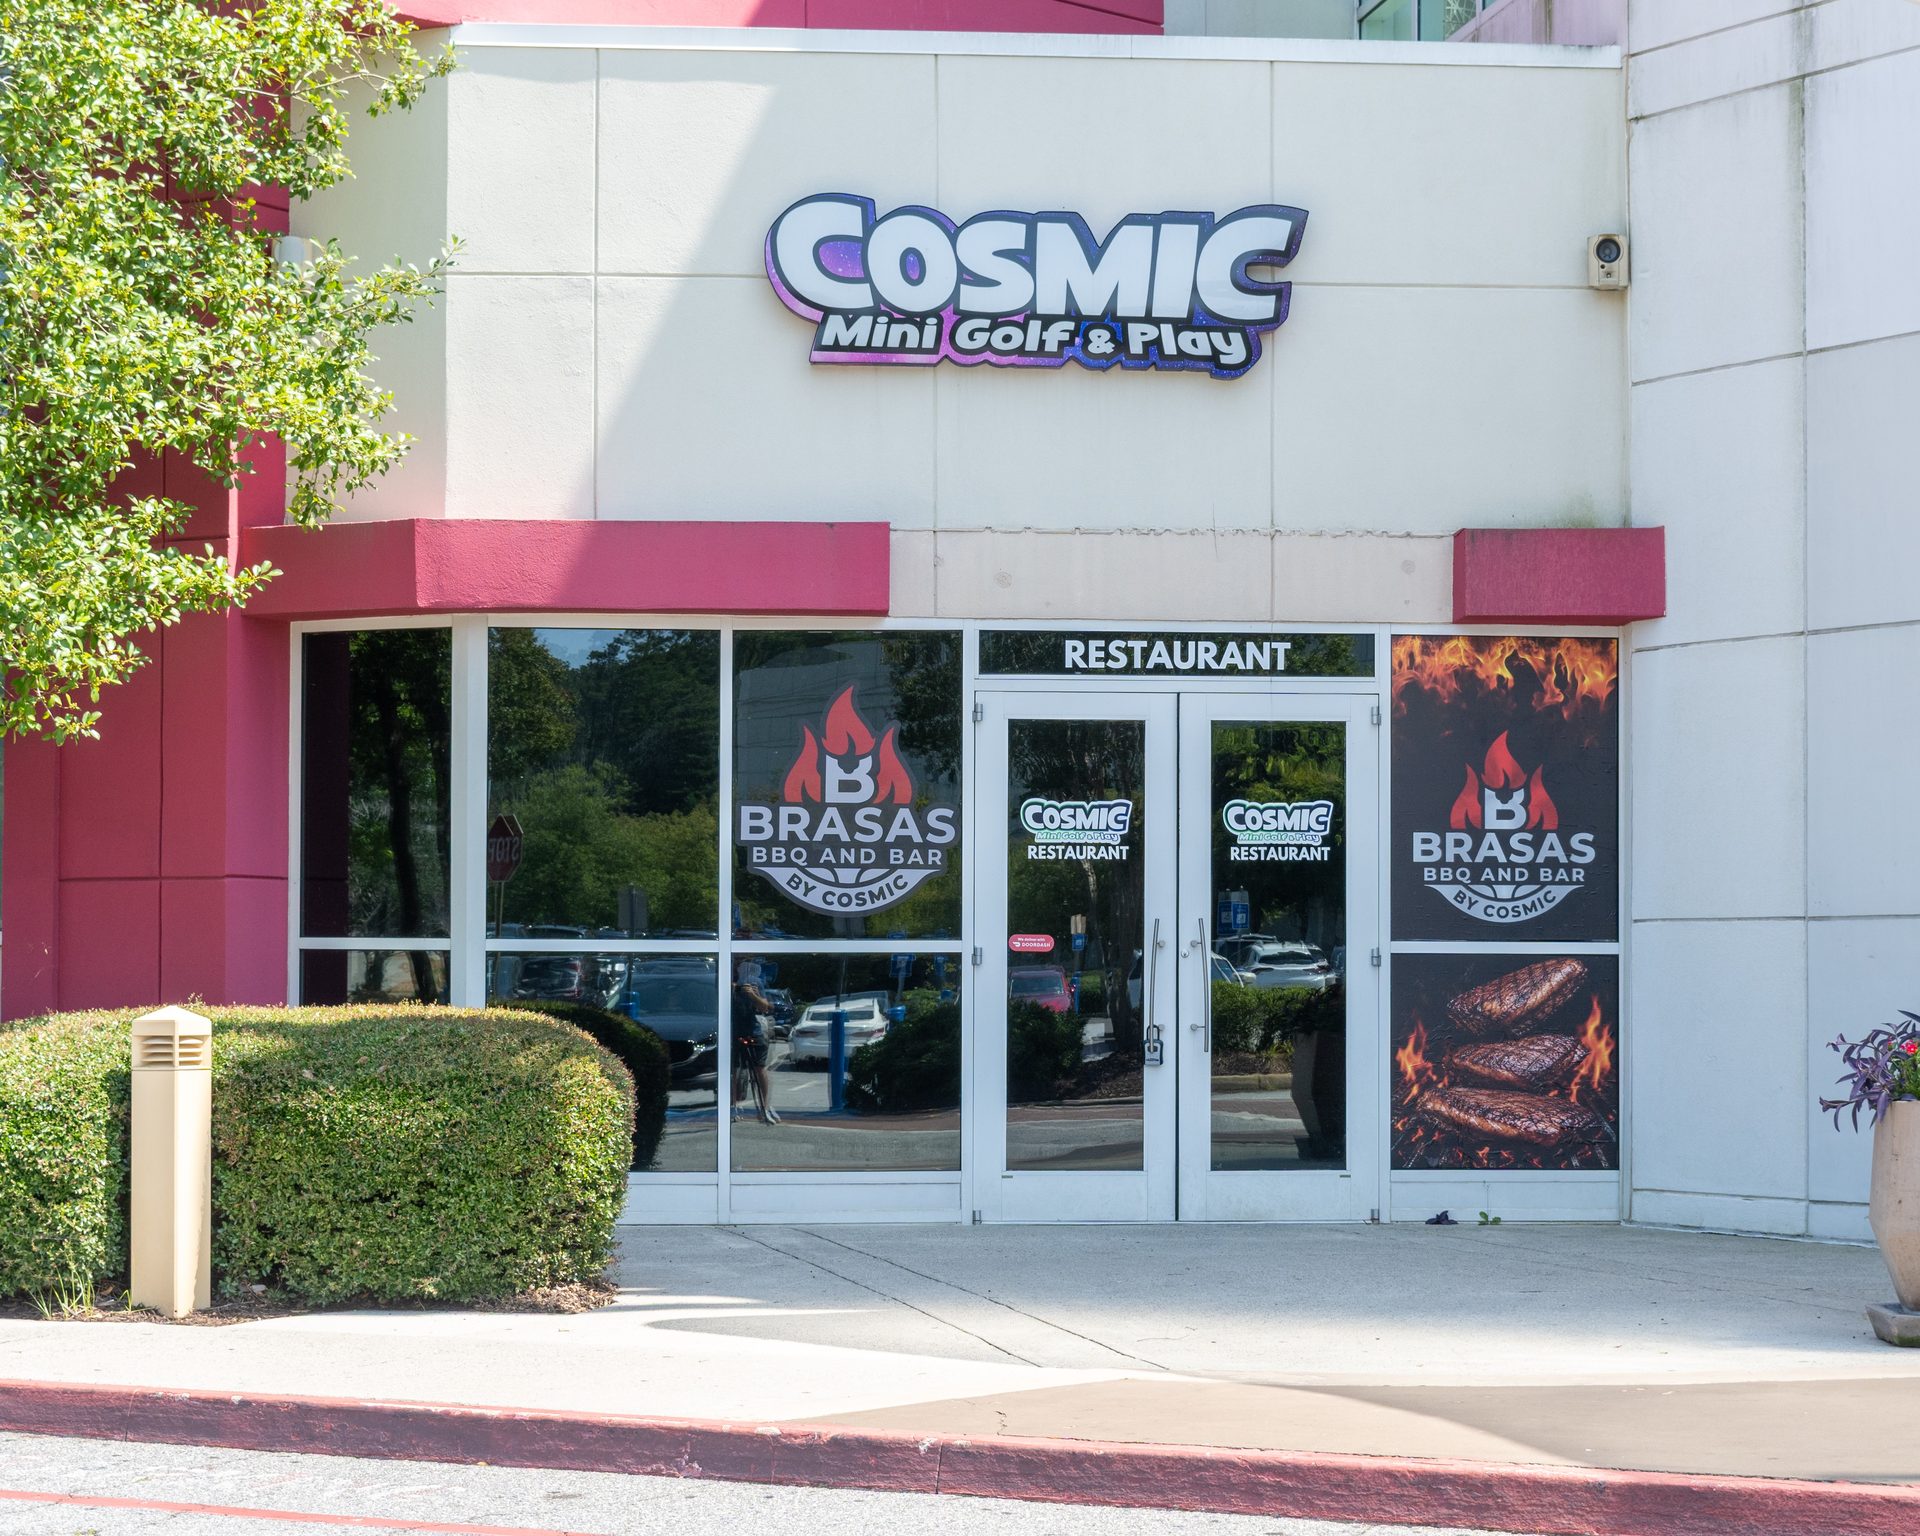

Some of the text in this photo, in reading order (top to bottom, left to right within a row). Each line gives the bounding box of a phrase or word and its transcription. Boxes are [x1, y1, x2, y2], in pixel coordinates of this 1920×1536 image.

[776, 200, 1293, 321] COSMIC
[821, 314, 1249, 363] Mini Golf & Play
[1064, 639, 1291, 671] RESTAURANT
[740, 805, 956, 844] BRASAS
[1024, 803, 1128, 831] COSMIC
[1226, 804, 1329, 832] COSMIC
[752, 846, 942, 867] BBQ AND BAR
[1027, 845, 1130, 860] RESTAURANT
[1230, 846, 1331, 861] RESTAURANT
[1412, 831, 1596, 864] BRASAS
[786, 872, 908, 908] BY COSMIC
[1423, 867, 1585, 884] BBQ AND BAR
[1453, 889, 1556, 919] BY COSMIC
